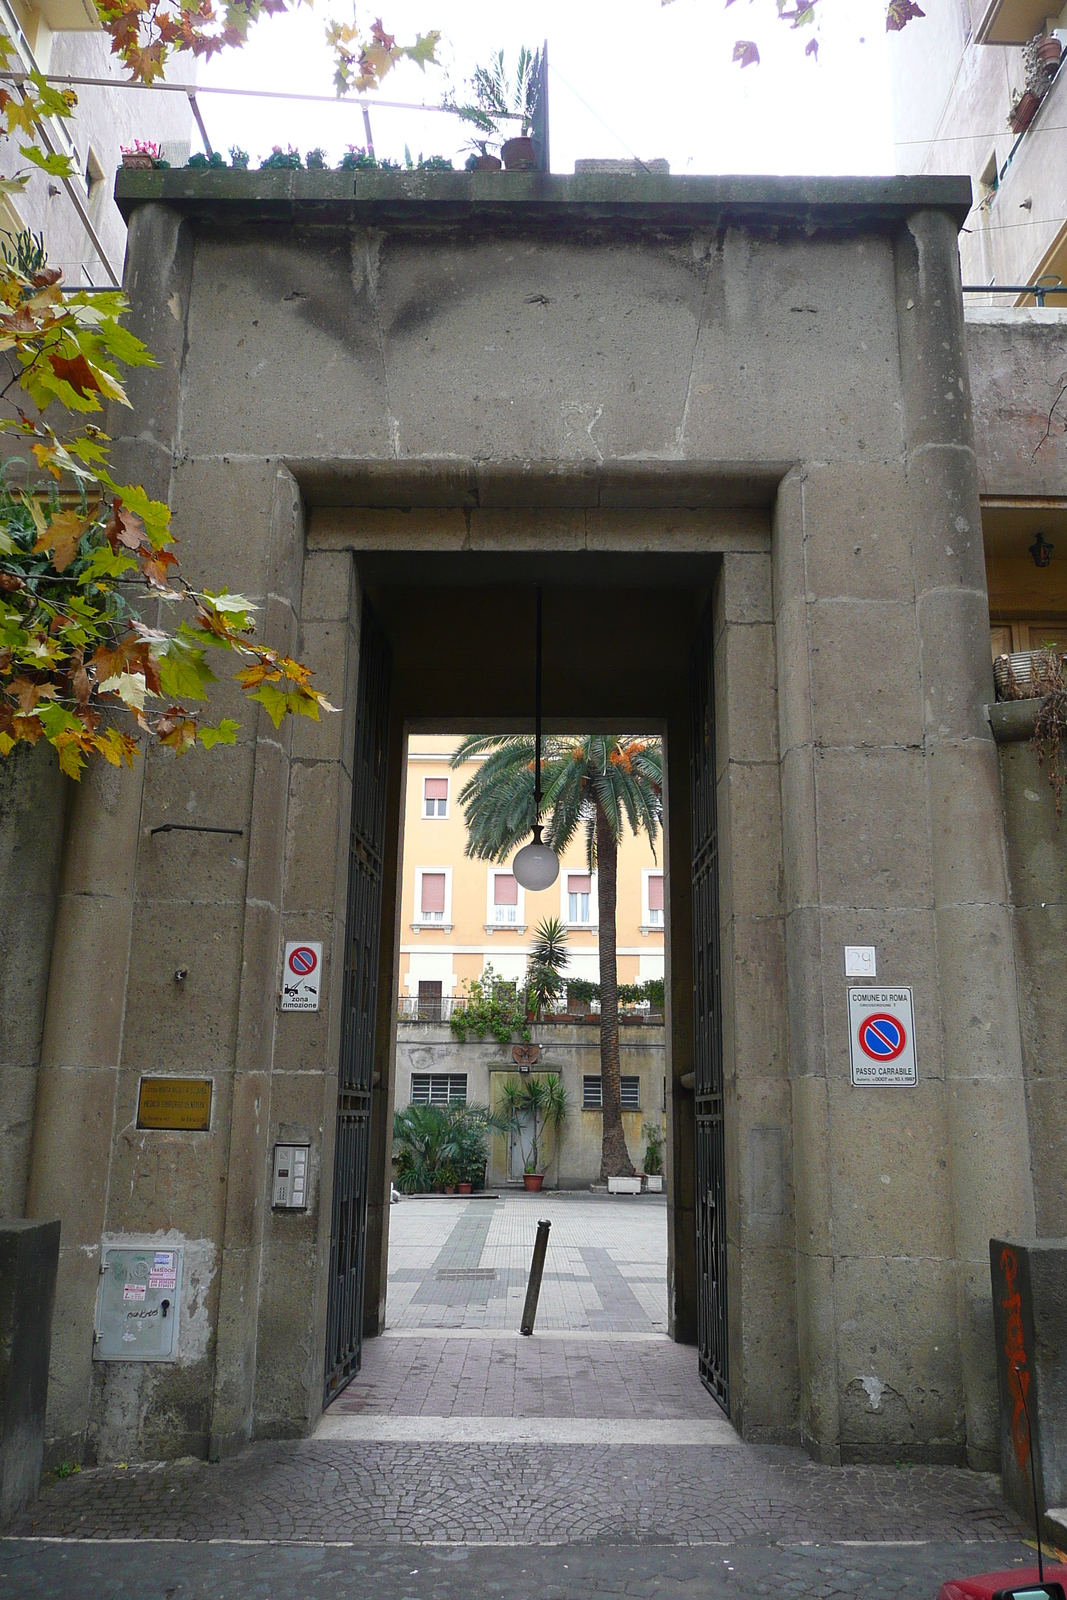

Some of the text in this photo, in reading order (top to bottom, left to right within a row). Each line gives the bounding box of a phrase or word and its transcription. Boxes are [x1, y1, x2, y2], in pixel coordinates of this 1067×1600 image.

[849, 951, 871, 971] 29
[855, 1067, 913, 1075] PASSO CARRABILE
